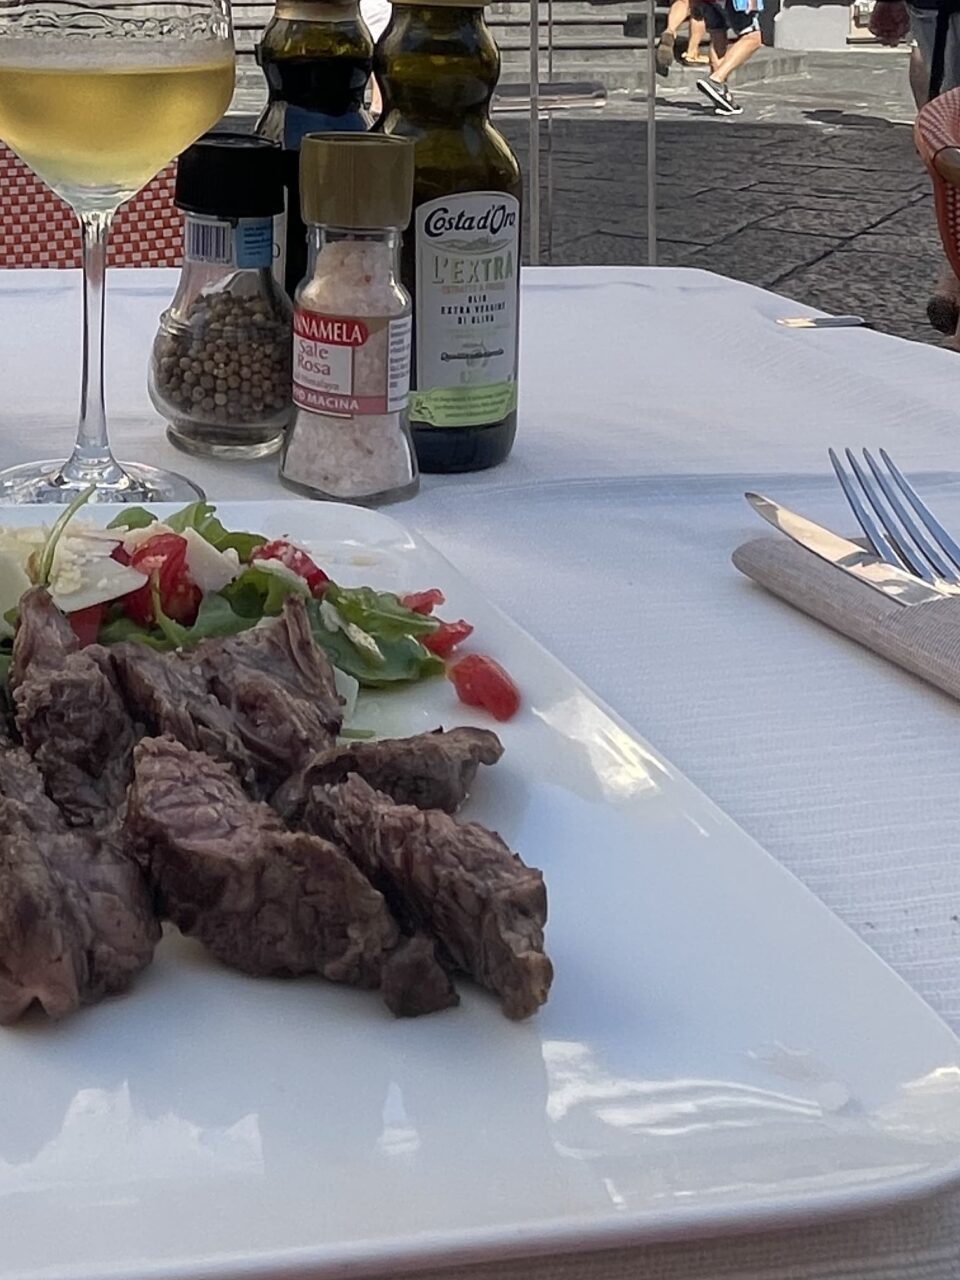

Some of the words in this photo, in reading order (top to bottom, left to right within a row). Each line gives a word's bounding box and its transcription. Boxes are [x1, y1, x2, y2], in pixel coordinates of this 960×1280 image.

[432, 251, 513, 285] L'EXTRA
[441, 306, 470, 315] EXTRA
[299, 340, 329, 360] Sale
[298, 354, 331, 376] Rosa
[307, 392, 359, 410] MACINA
